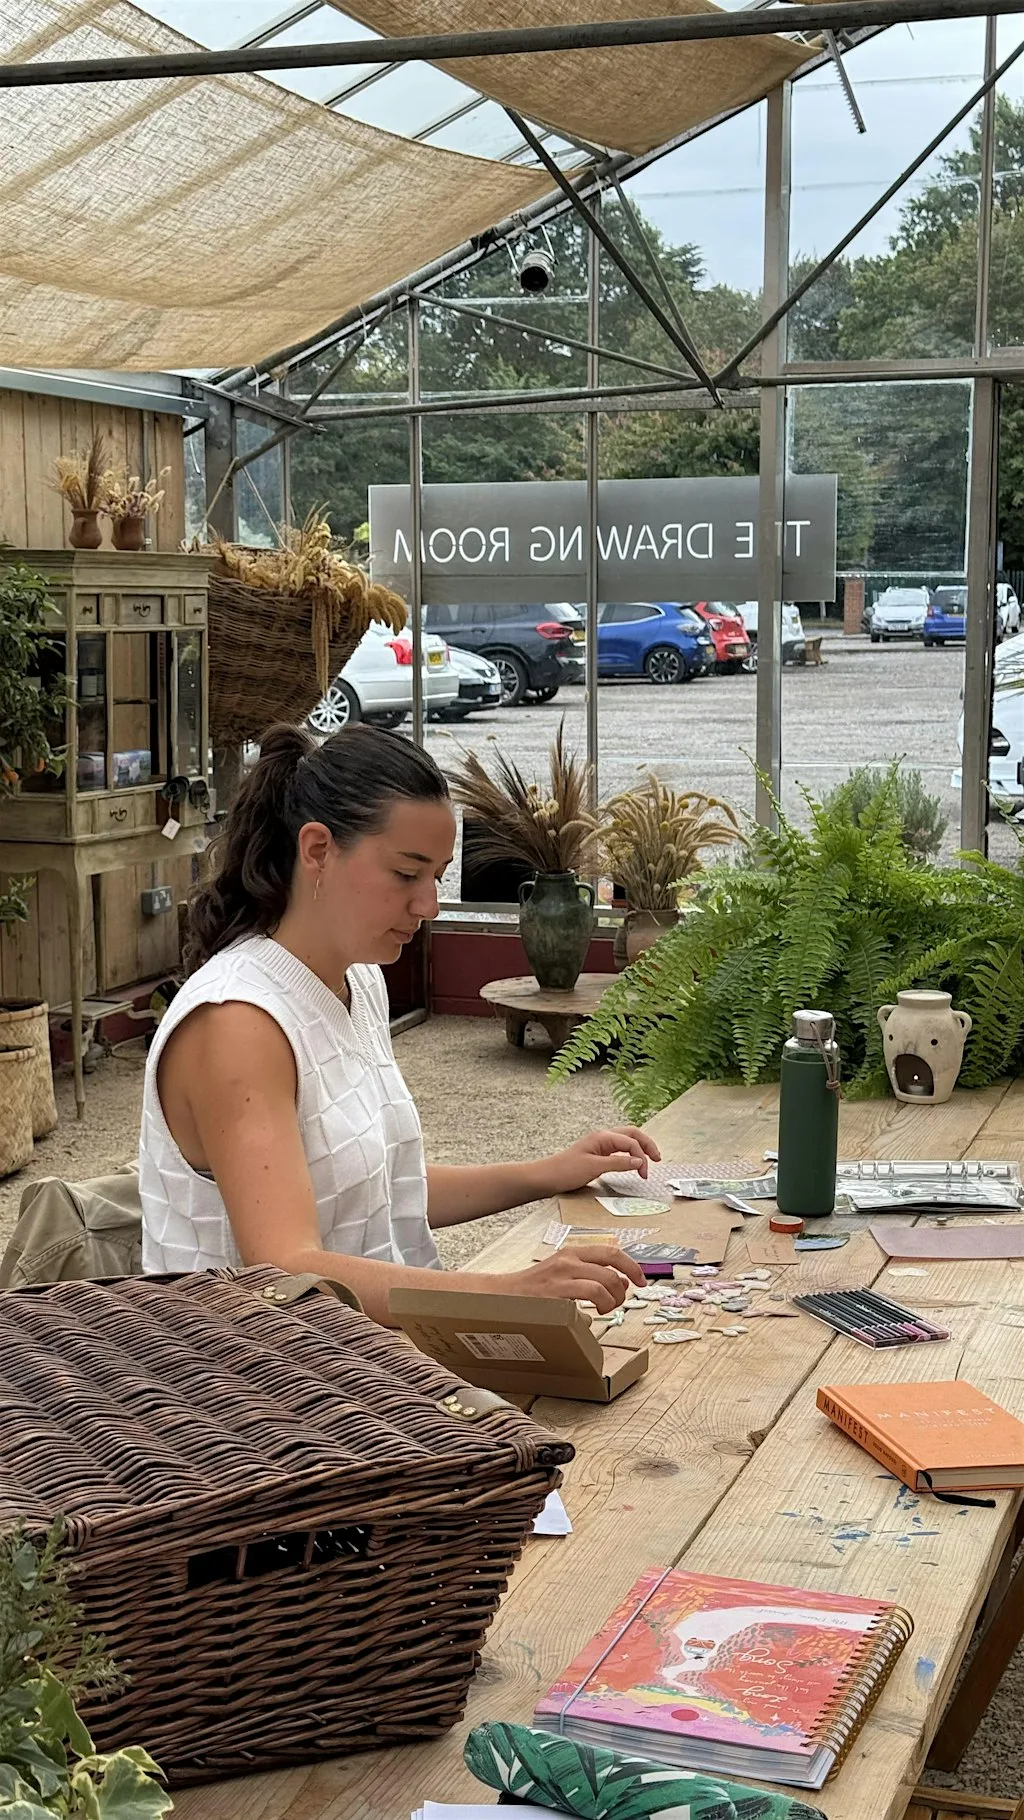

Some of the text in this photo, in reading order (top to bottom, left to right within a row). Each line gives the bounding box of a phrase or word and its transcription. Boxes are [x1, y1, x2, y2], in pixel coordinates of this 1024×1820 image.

[823, 1399, 869, 1443] MANIFEST
[876, 1407, 997, 1420] MANIFEST
[731, 1647, 794, 1673] Song
[732, 1685, 787, 1703] Long
[776, 1684, 789, 1692] the
[795, 1686, 810, 1694] but
